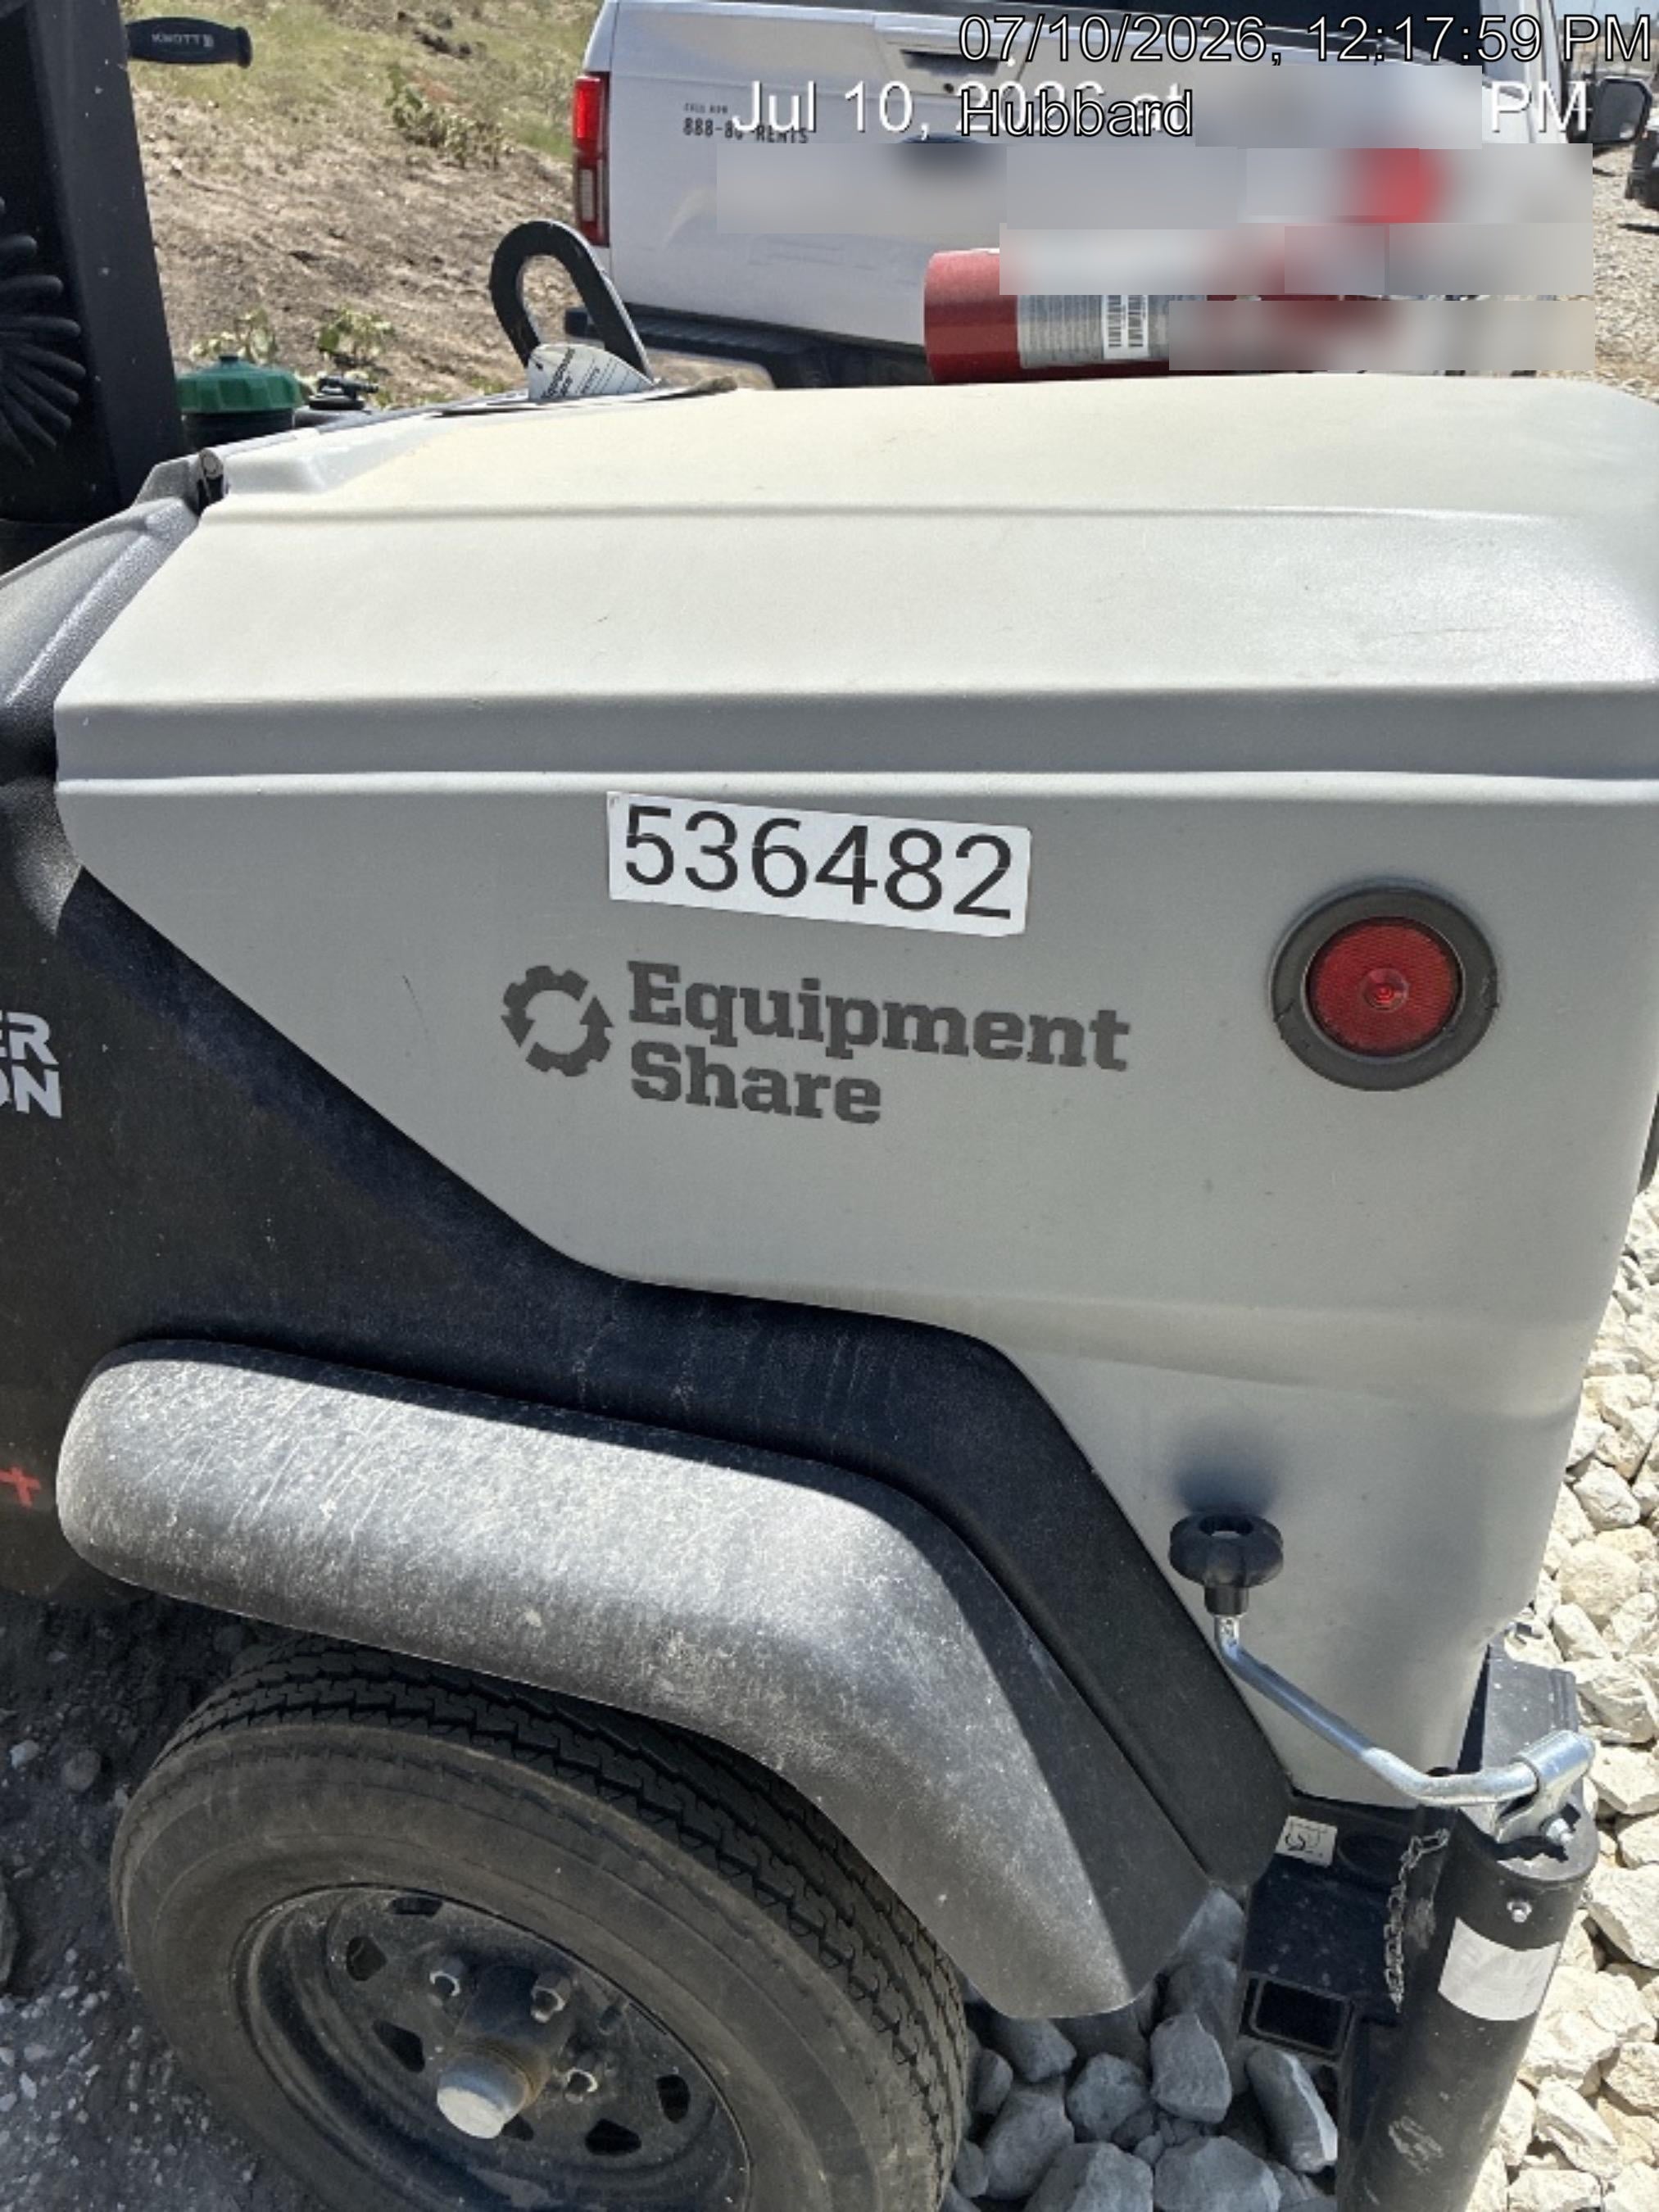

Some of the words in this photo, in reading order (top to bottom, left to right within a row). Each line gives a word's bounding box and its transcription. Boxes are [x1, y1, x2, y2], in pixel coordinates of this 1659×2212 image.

[625, 804, 1013, 919] 536482
[627, 960, 1131, 1072] Equipment
[630, 1040, 882, 1124] Share
